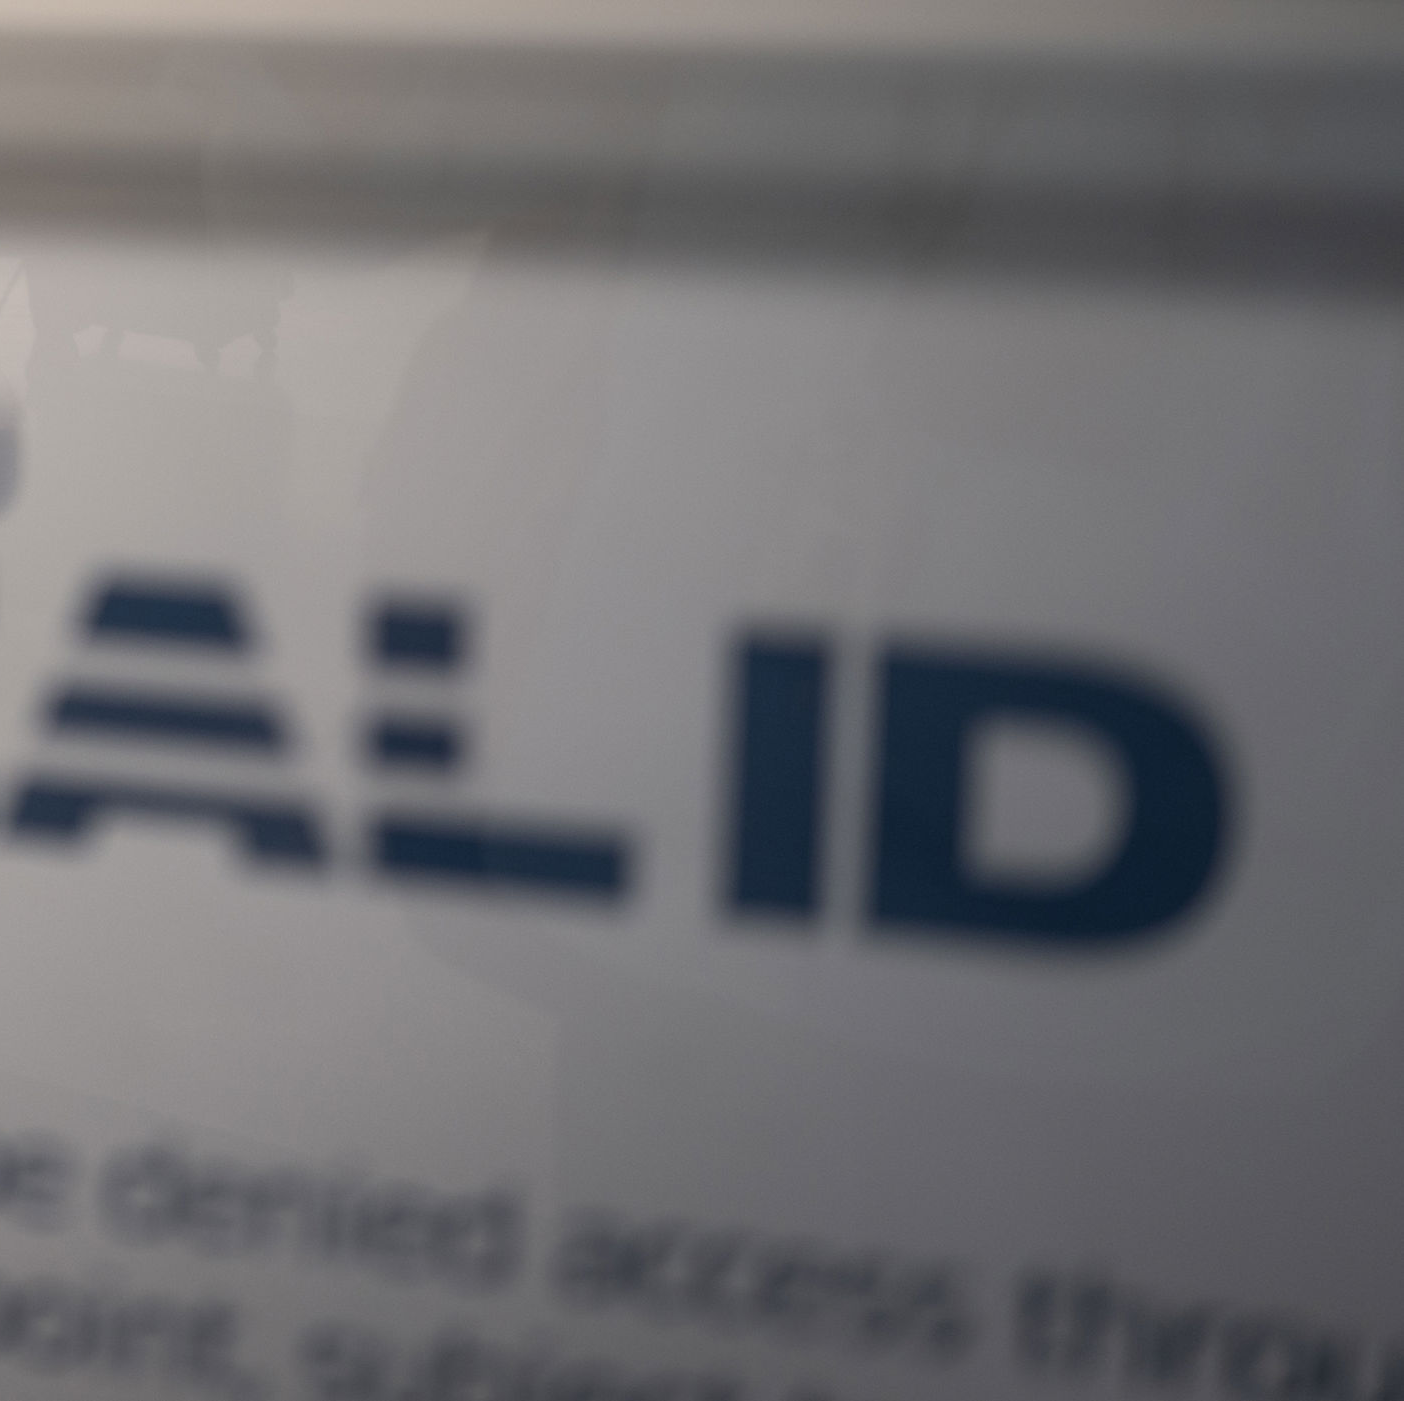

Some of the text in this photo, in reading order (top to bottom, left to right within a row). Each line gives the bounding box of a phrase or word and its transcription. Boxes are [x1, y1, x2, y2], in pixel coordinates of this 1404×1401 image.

[723, 622, 1238, 967] ID
[100, 1133, 523, 1296] denied
[556, 1214, 981, 1370] access
